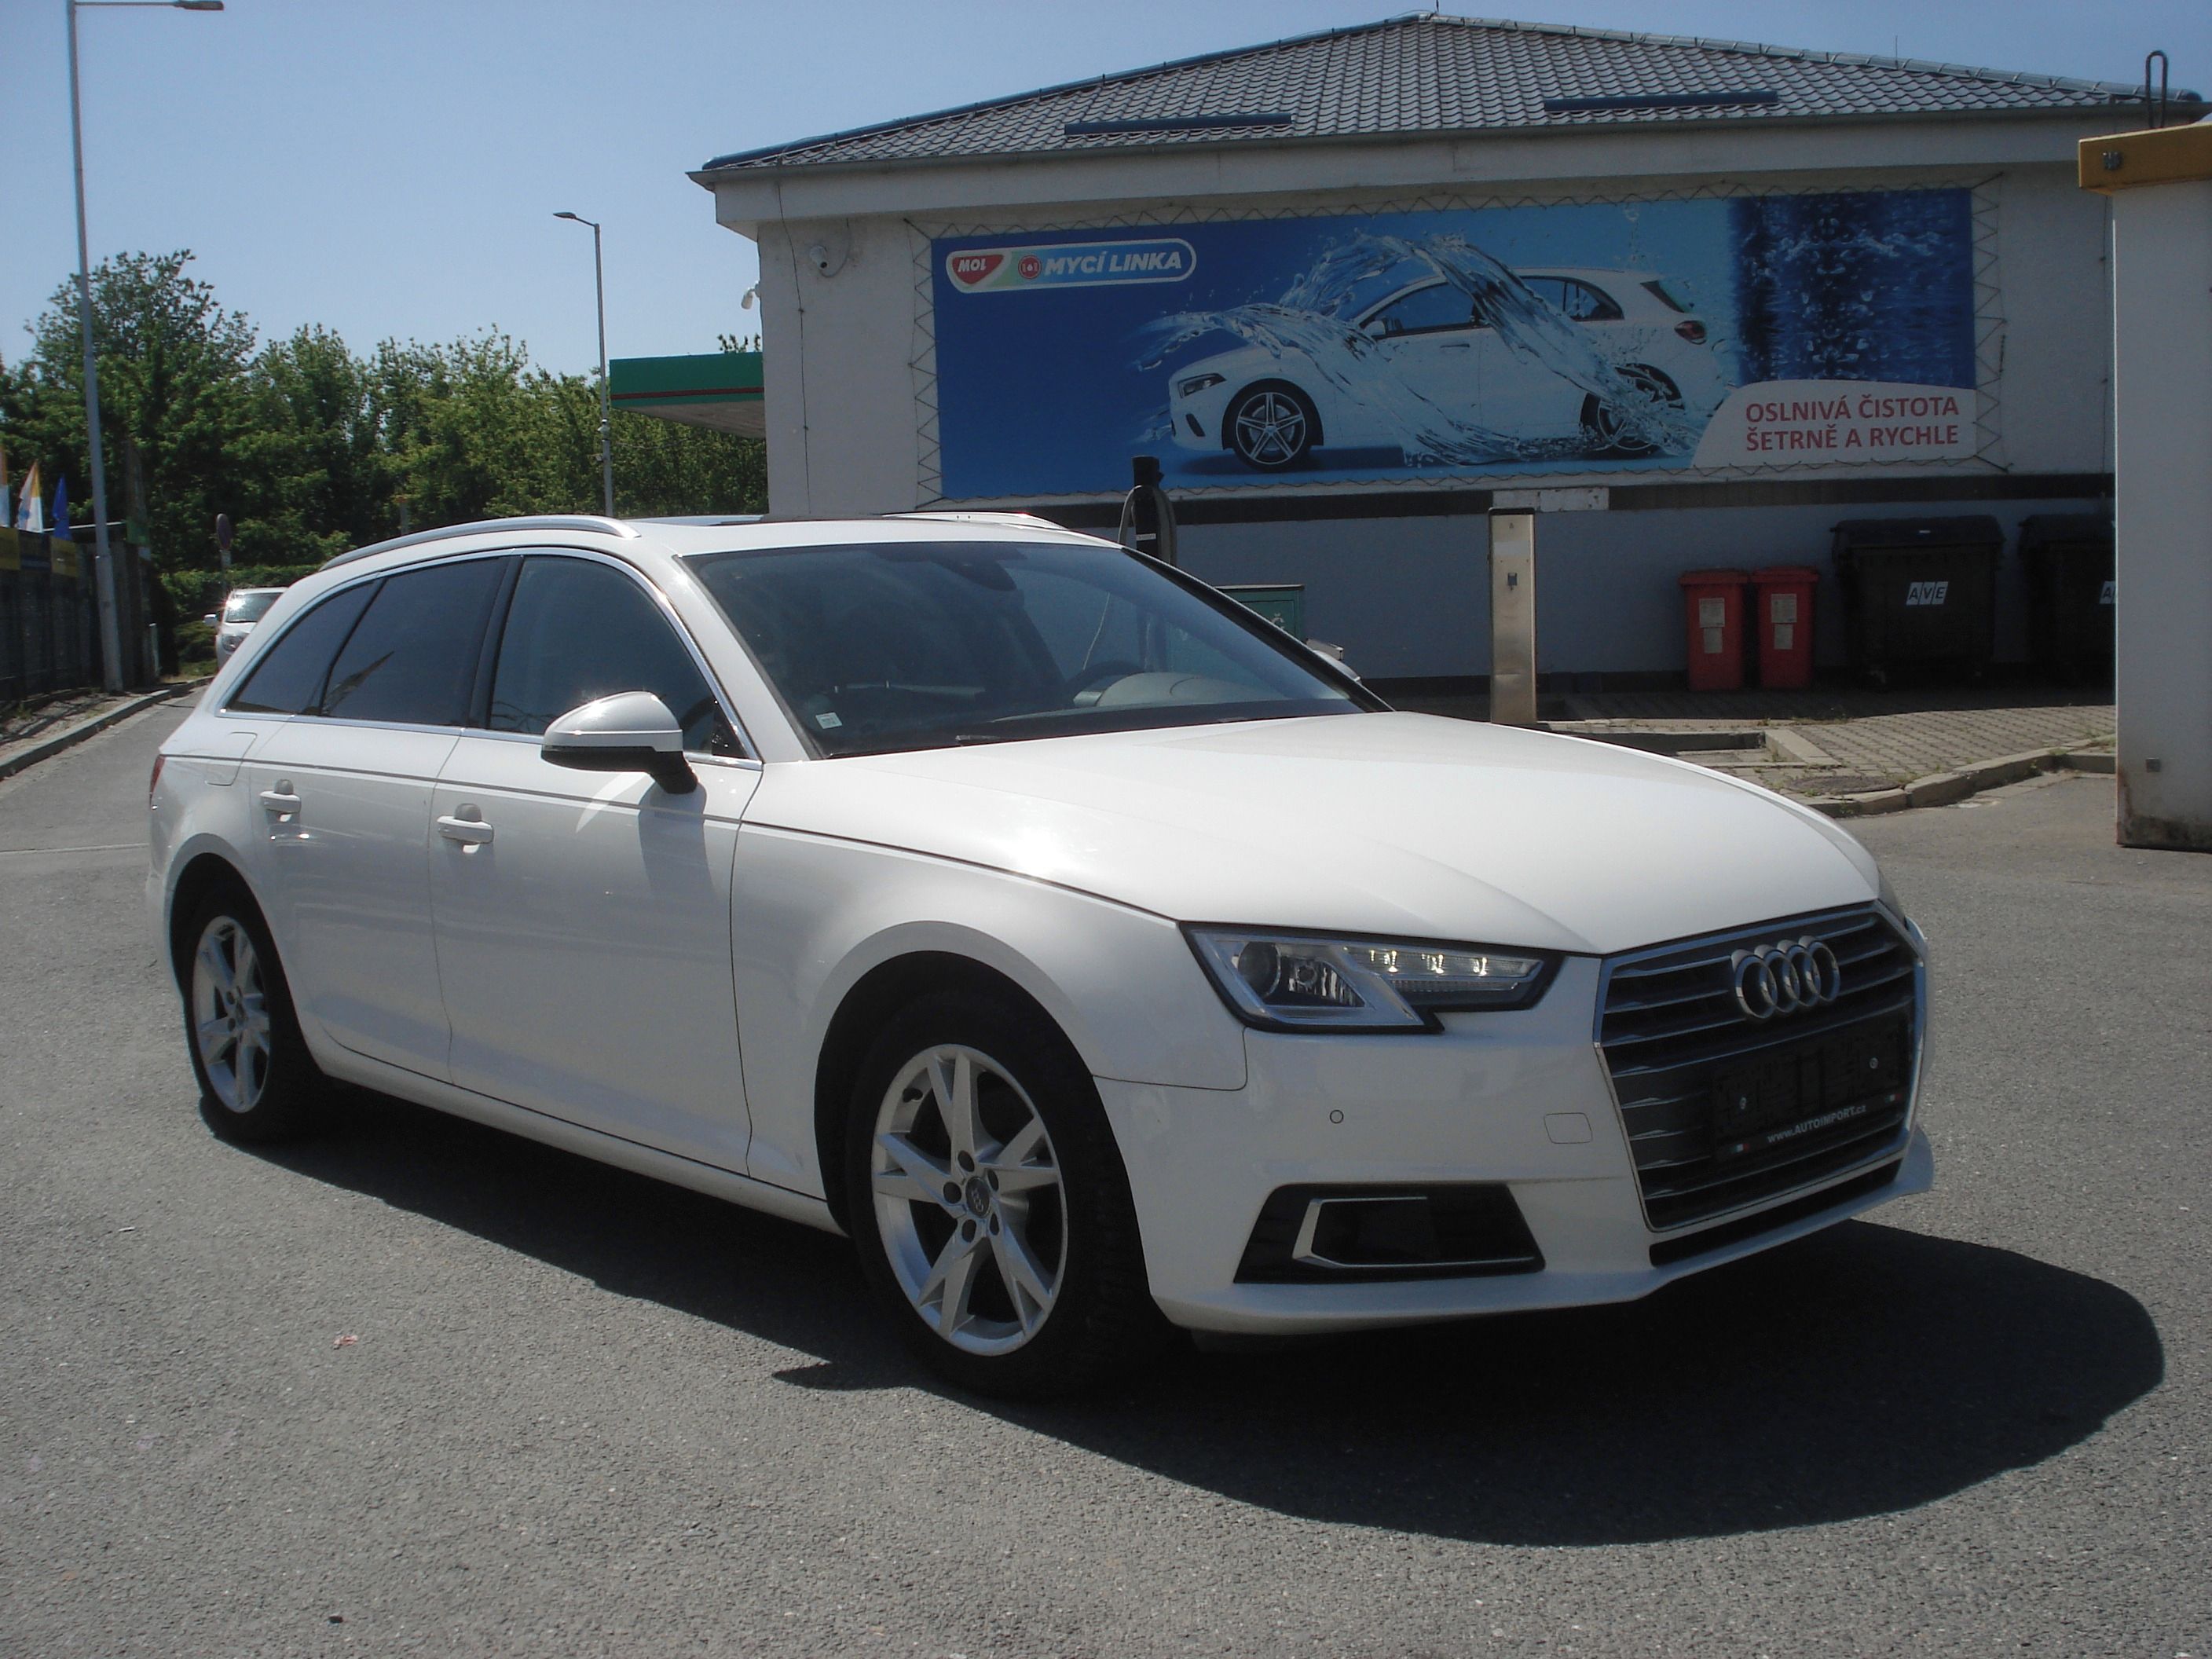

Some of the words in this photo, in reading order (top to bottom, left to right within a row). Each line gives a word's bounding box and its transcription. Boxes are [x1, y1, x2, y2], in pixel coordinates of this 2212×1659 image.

[958, 258, 987, 273] MOL
[1045, 251, 1106, 276] MYCÍ
[1108, 251, 1182, 273] LINKA
[1745, 395, 1851, 423] OSLNIVÁ
[1859, 394, 1959, 419] ČISTOTA
[1746, 423, 1838, 451] ŠETRNĚ
[1845, 428, 1862, 448] A
[1870, 425, 1959, 447] RYCHLE
[1909, 586, 1946, 600] AVE
[1767, 1104, 1867, 1144] www.AUTOIMPORT.cz
